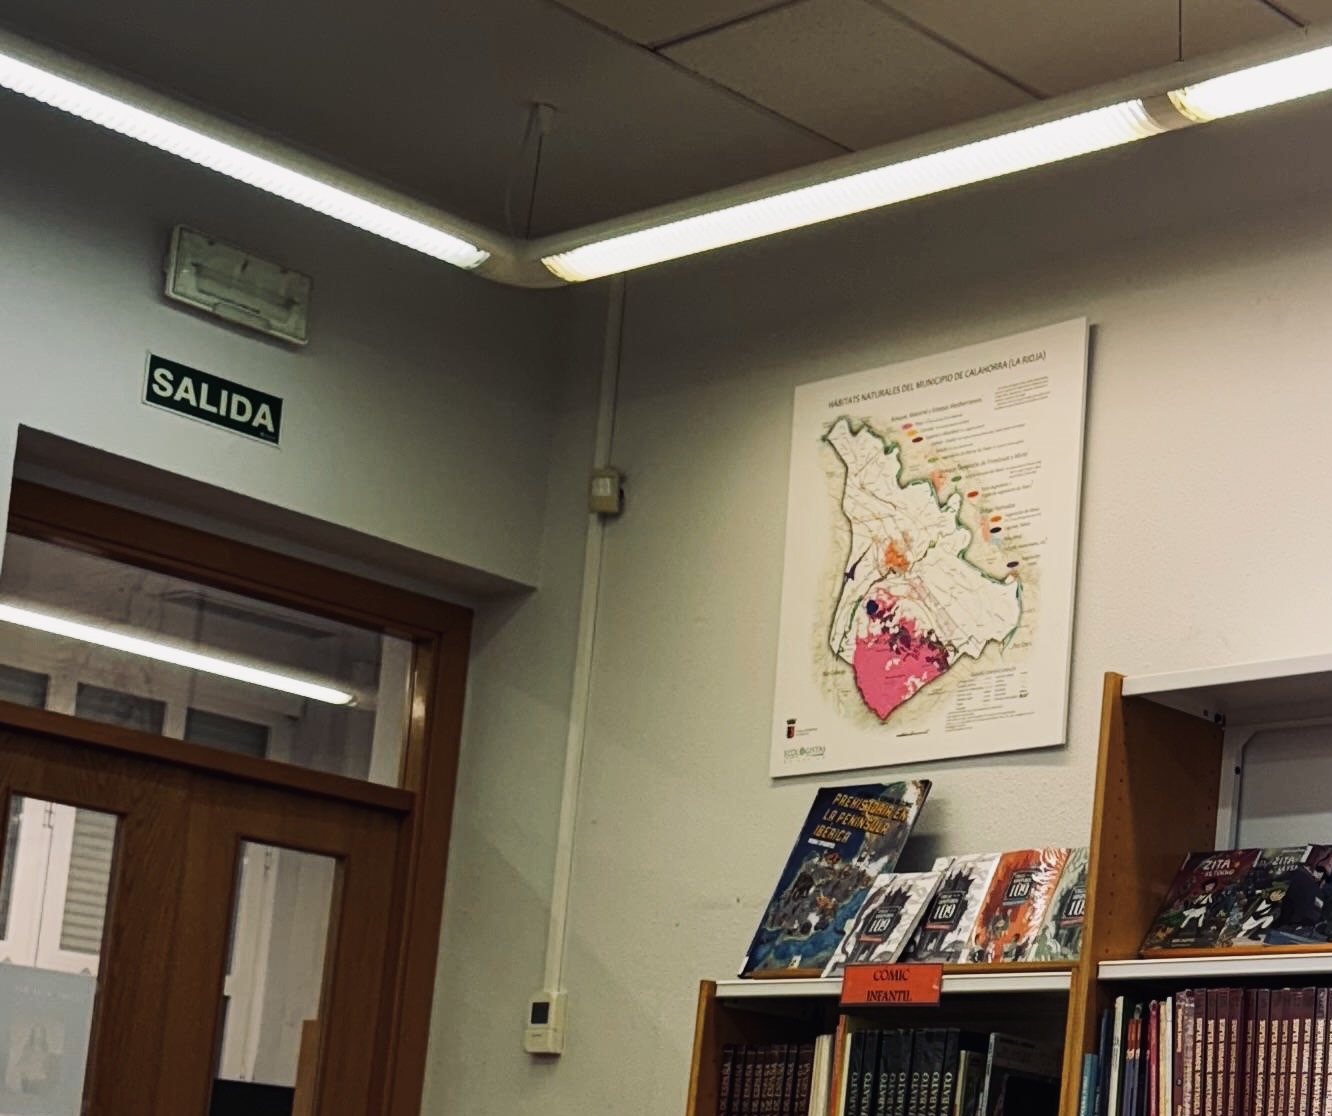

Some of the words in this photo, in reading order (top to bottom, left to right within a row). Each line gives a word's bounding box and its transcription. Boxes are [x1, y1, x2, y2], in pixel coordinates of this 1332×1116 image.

[861, 384, 901, 401] NATURALES
[901, 383, 914, 393] DEL
[916, 373, 954, 389] MUNICIPIO
[954, 371, 963, 380] DE
[965, 360, 1008, 378] CALAHORRA
[1008, 357, 1021, 369] (LA
[1022, 350, 1047, 365] RIOJA)
[151, 367, 275, 434] SALIDA
[831, 792, 893, 818] PREHISTORIA
[894, 806, 910, 822] EN
[822, 809, 838, 822] LA
[1203, 859, 1231, 870] ZITA
[1272, 855, 1295, 866] ZITA
[1008, 881, 1030, 898] 109
[934, 902, 956, 921] 109
[871, 918, 888, 934] 109
[865, 988, 913, 1002] INFANTIL
